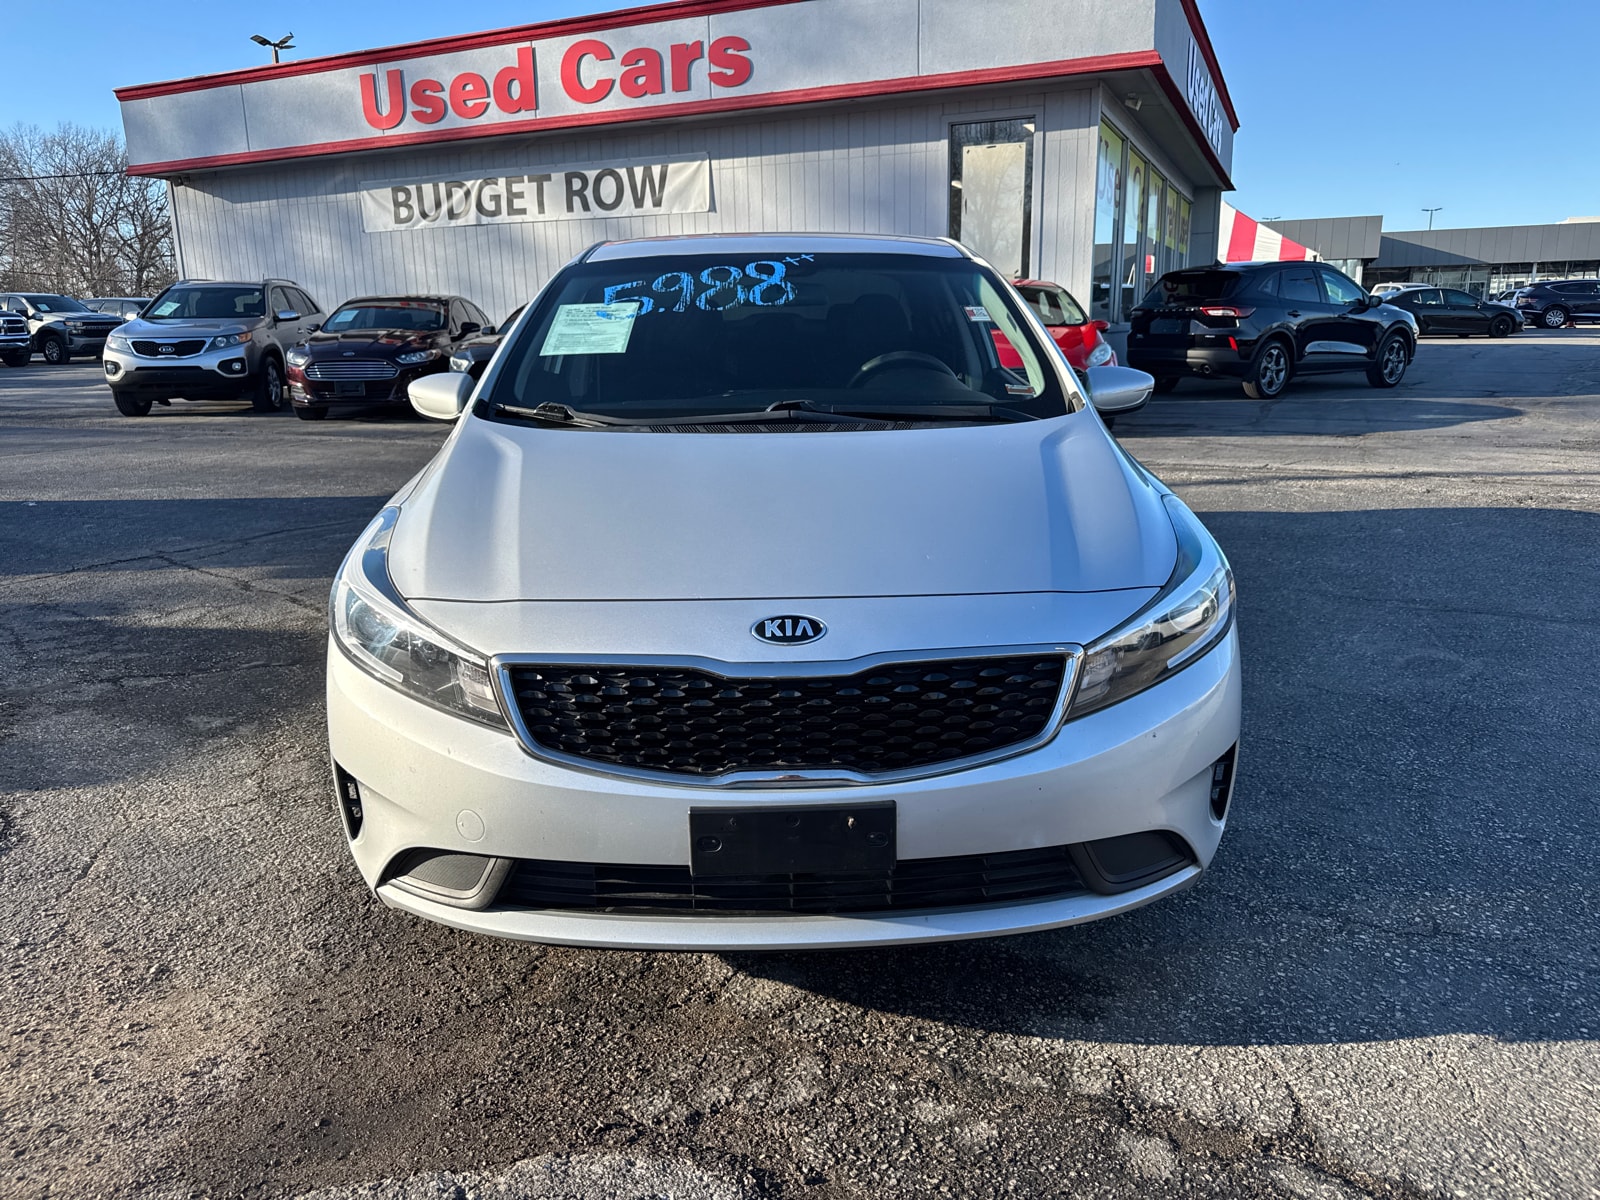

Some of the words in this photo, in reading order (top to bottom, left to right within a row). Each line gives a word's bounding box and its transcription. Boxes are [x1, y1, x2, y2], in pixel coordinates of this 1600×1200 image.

[359, 47, 537, 130] Used
[560, 36, 752, 104] Cars
[1187, 37, 1210, 129] Used
[1208, 87, 1223, 155] Cars
[390, 174, 551, 225] BUDGET
[564, 164, 669, 213] ROW
[764, 618, 814, 637] KIA
